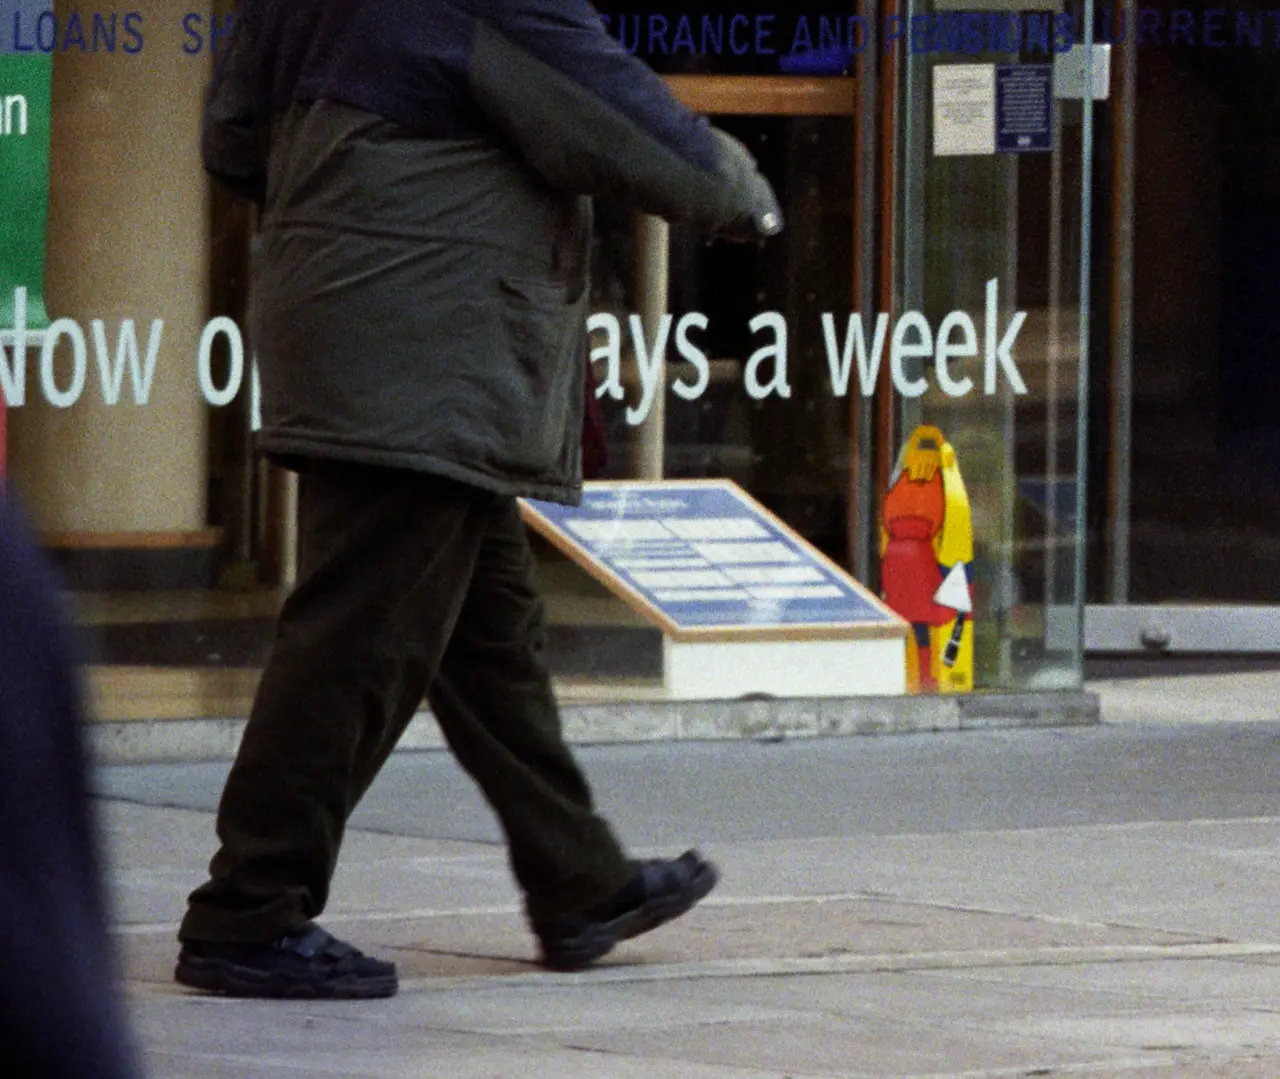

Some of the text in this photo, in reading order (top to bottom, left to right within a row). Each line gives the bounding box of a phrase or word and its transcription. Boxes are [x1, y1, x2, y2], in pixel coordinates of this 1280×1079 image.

[13, 11, 144, 54] LOANS
[791, 13, 870, 55] AND
[744, 310, 791, 400] a
[821, 277, 1029, 398] week
